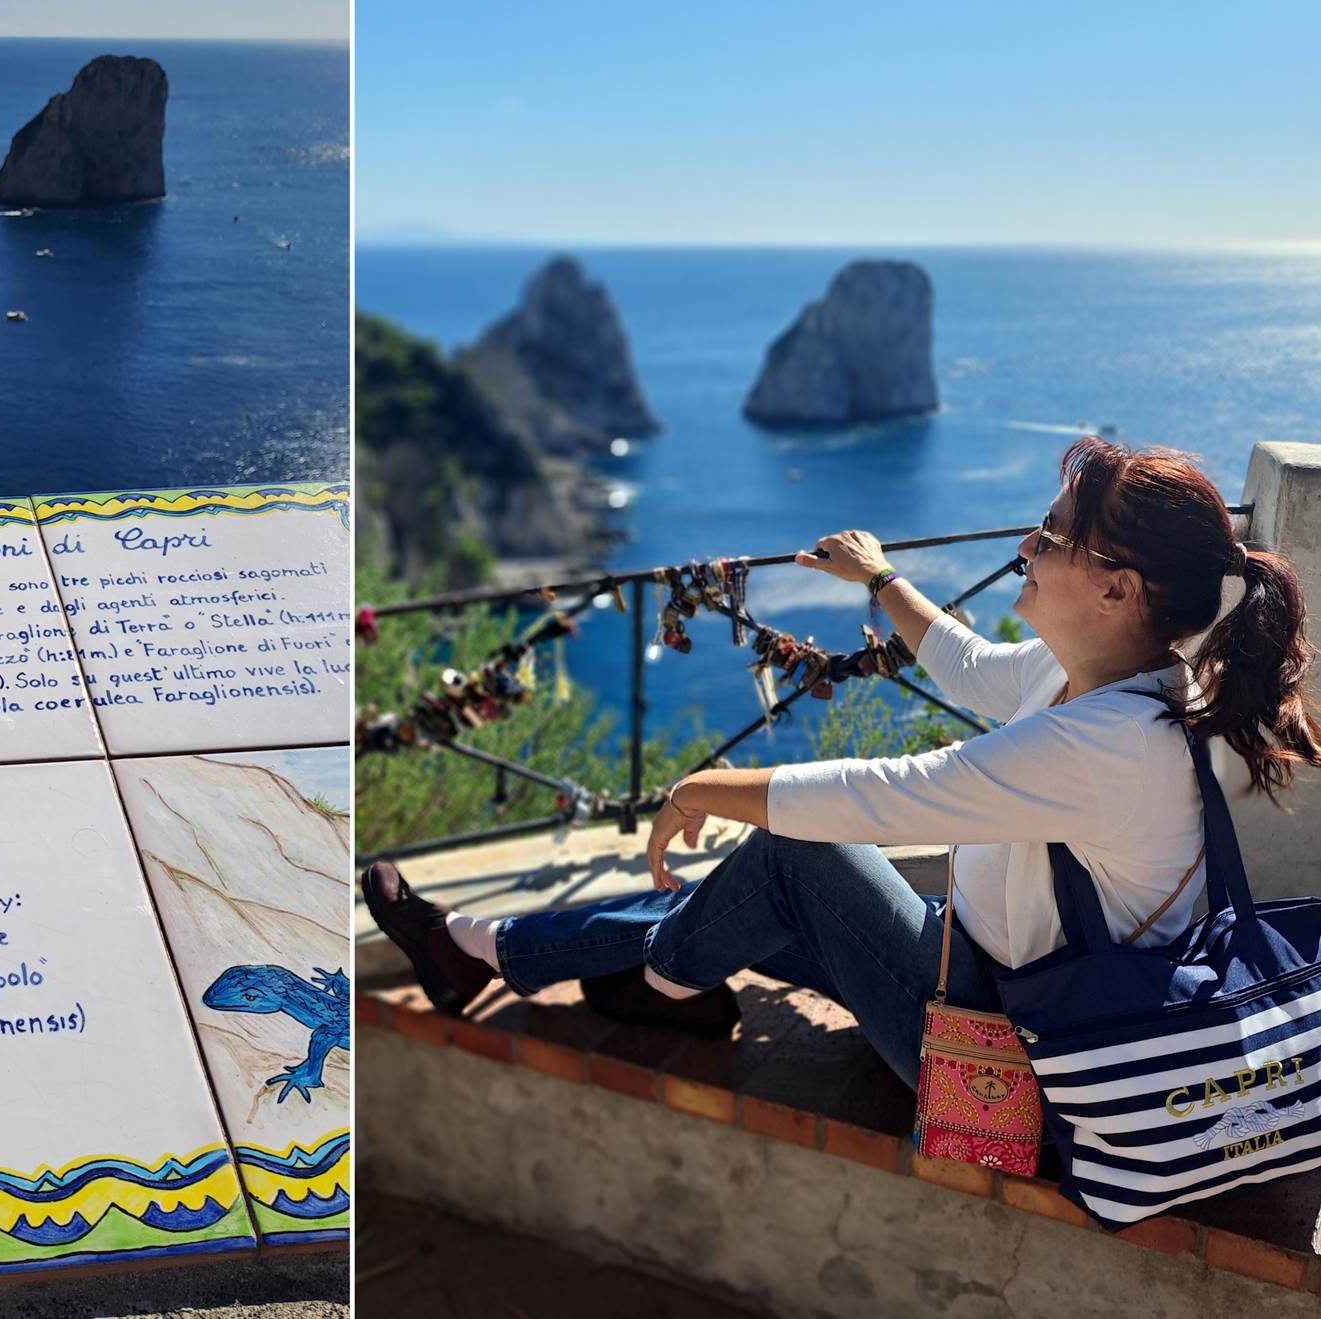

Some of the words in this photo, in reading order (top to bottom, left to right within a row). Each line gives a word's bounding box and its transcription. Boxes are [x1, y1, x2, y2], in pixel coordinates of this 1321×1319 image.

[52, 533, 85, 555] di
[115, 527, 212, 556] Capri
[9, 580, 49, 592] sono
[61, 575, 89, 588] tre
[100, 572, 147, 589] picchi
[158, 568, 228, 584] rocciosi
[238, 562, 328, 582] sagomati
[17, 604, 26, 614] e
[40, 597, 86, 616] dagli
[97, 594, 156, 613] agenti
[170, 590, 285, 607] atmosferici.
[89, 620, 110, 636] di
[184, 620, 195, 631] o
[124, 646, 134, 657] e
[257, 638, 277, 652] di
[15, 673, 59, 690] Solo
[71, 674, 96, 686] su
[110, 664, 236, 687] quest'ultimo
[245, 665, 285, 677] vive
[294, 660, 318, 675] la
[35, 690, 143, 711] coerulea
[153, 676, 320, 705] Faraglionensis).
[1165, 1057, 1305, 1118] CAPRI
[1223, 1130, 1284, 1162] ITALIA
